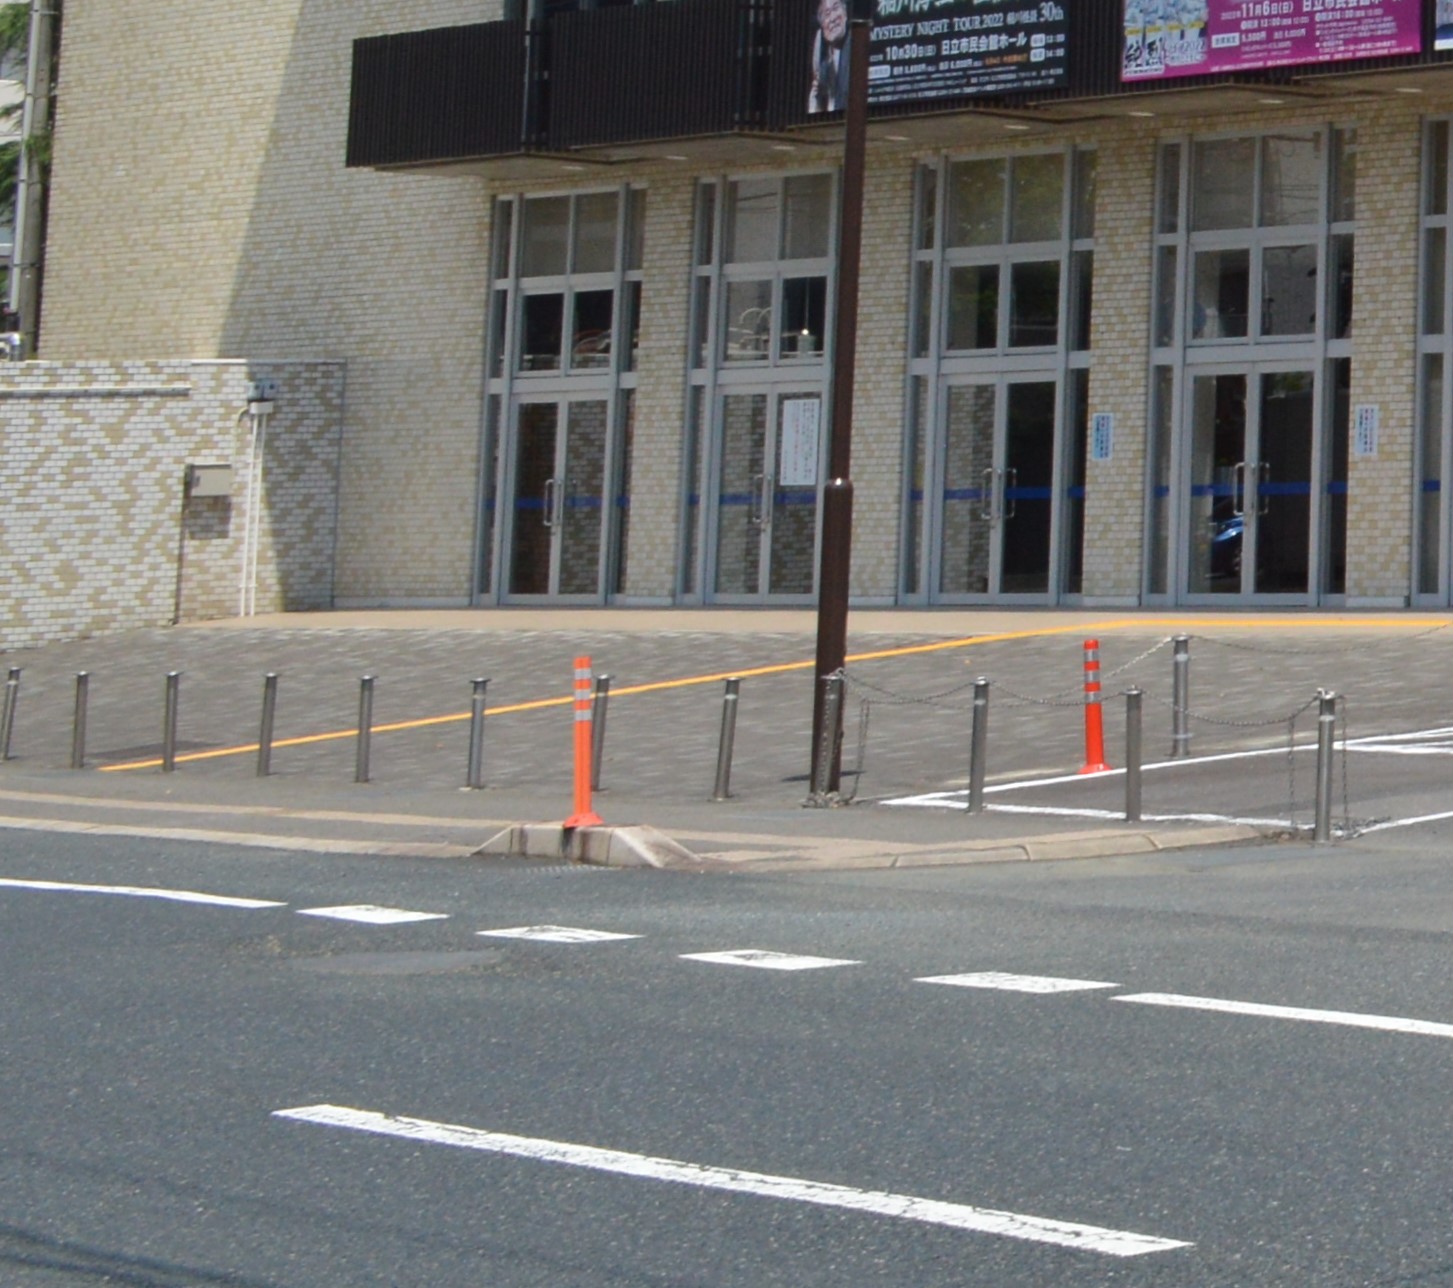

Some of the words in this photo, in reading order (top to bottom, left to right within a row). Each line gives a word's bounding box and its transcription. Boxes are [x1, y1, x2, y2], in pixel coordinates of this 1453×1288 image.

[869, 22, 914, 42] MYSTERY
[916, 20, 950, 37] NIGHT
[953, 16, 981, 32] TOUR
[941, 31, 1028, 56] 日立市民会館ホール
